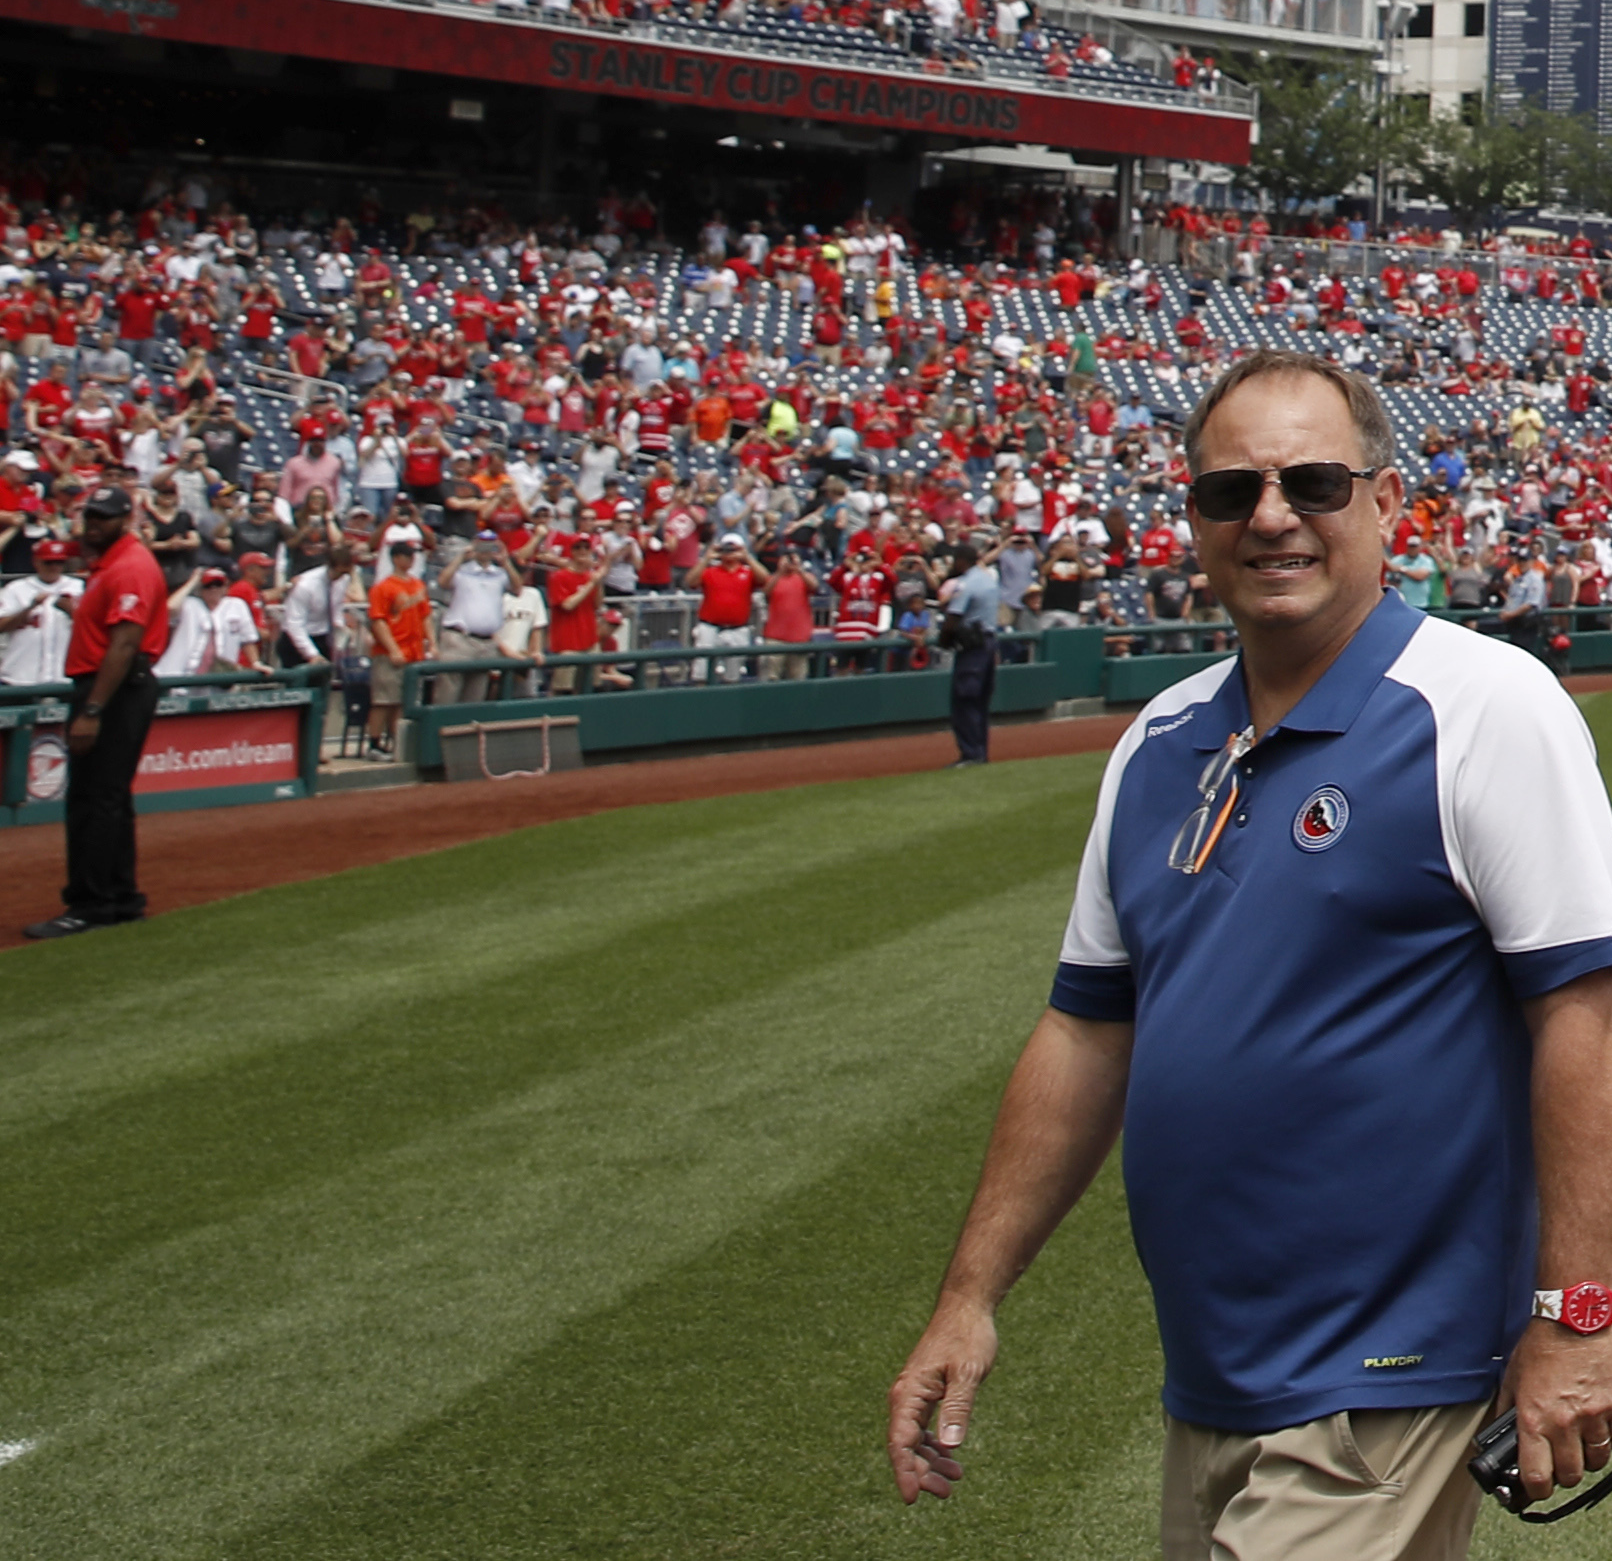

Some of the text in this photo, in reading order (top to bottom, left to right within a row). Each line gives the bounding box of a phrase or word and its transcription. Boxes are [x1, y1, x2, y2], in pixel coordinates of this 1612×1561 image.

[549, 40, 1020, 132] STANLEY CUP CHAMPIONS
